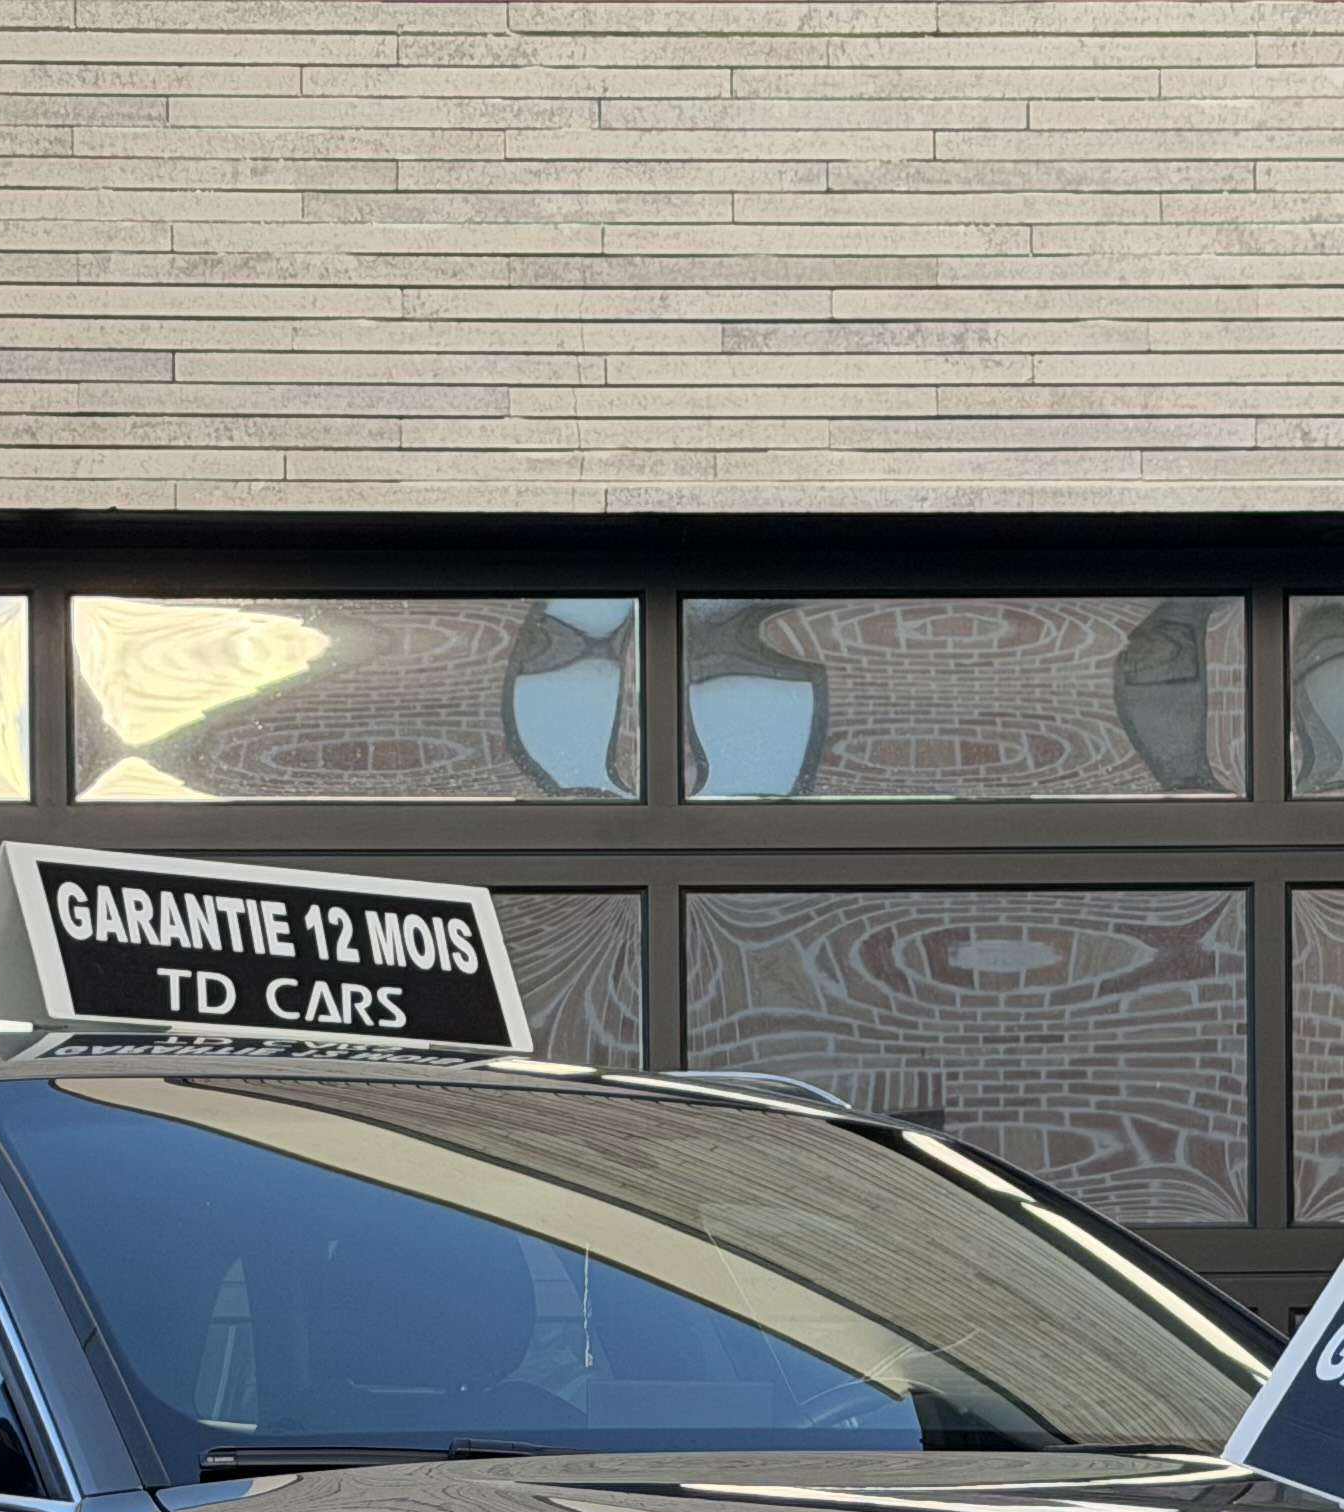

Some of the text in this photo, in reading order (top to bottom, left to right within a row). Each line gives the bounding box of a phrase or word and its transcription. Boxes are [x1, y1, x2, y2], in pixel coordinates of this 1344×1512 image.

[57, 881, 479, 974] GARANTIE 12 MOIS
[157, 967, 407, 1028] TD CARS
